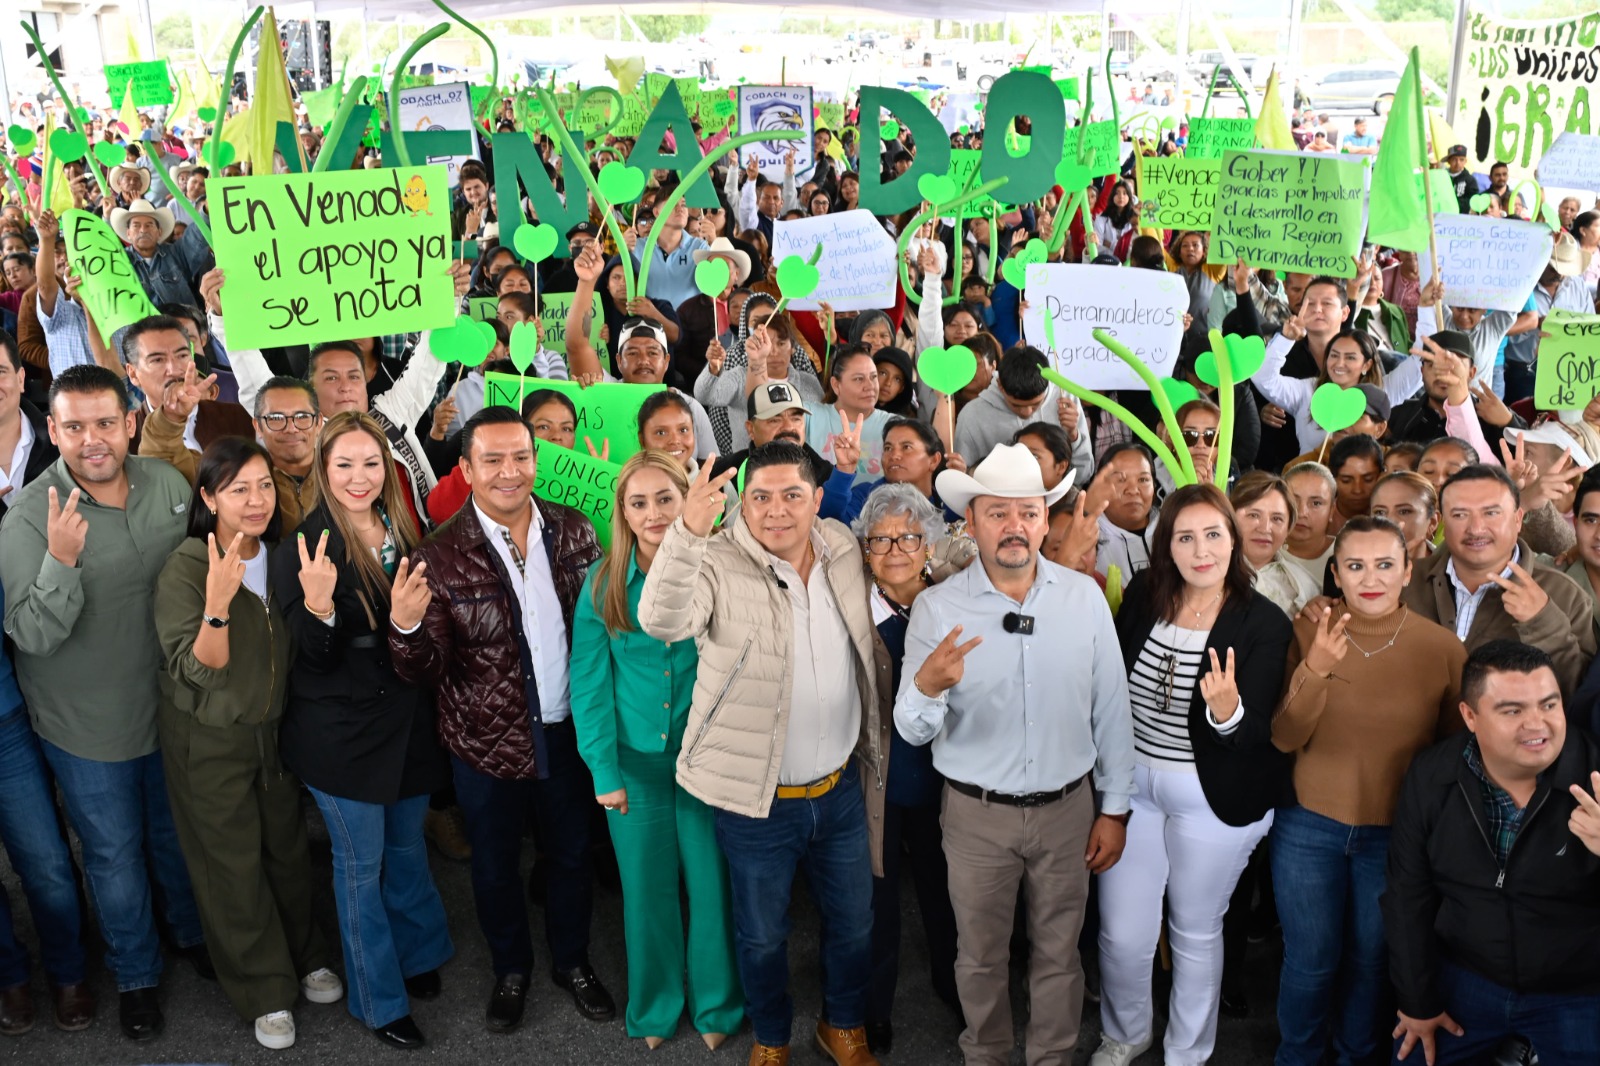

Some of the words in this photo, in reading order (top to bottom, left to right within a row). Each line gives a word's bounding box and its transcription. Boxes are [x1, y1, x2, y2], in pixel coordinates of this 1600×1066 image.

[400, 94, 441, 105] OBACH
[448, 91, 463, 99] 07
[745, 91, 787, 101] COBACH
[792, 93, 806, 101] 07
[1197, 119, 1252, 133] PADRINO
[1475, 81, 1600, 168] ¡GRA
[1190, 147, 1206, 157] TE
[1143, 163, 1221, 186] #Venad
[1228, 154, 1289, 183] Gober
[223, 185, 276, 234] En
[285, 169, 410, 227] Venad
[1158, 189, 1179, 207] es
[1190, 187, 1216, 209] tu
[1221, 183, 1279, 199] gracias
[1286, 189, 1308, 203] por
[1159, 210, 1212, 226] casa
[1223, 201, 1237, 216] el
[1241, 202, 1313, 222] desarrollo
[1318, 211, 1338, 224] en
[1217, 220, 1271, 239] Nuestra
[1434, 223, 1484, 238] Gracias
[1218, 240, 1348, 272] Derramaderos
[1449, 240, 1476, 253] por
[1482, 240, 1528, 253] mover
[254, 238, 281, 280] el
[298, 239, 398, 285] apoyo
[407, 235, 446, 279] ya
[679, 254, 687, 266] H
[1437, 255, 1445, 268] a
[1451, 253, 1480, 270] San
[1486, 254, 1520, 271] Luis
[830, 265, 842, 280] de
[1441, 273, 1475, 287] hacia
[1482, 274, 1531, 288] adelan
[262, 297, 319, 330] se
[334, 267, 422, 322] nota
[1045, 295, 1175, 327] Derramaderos
[1549, 384, 1575, 406] de
